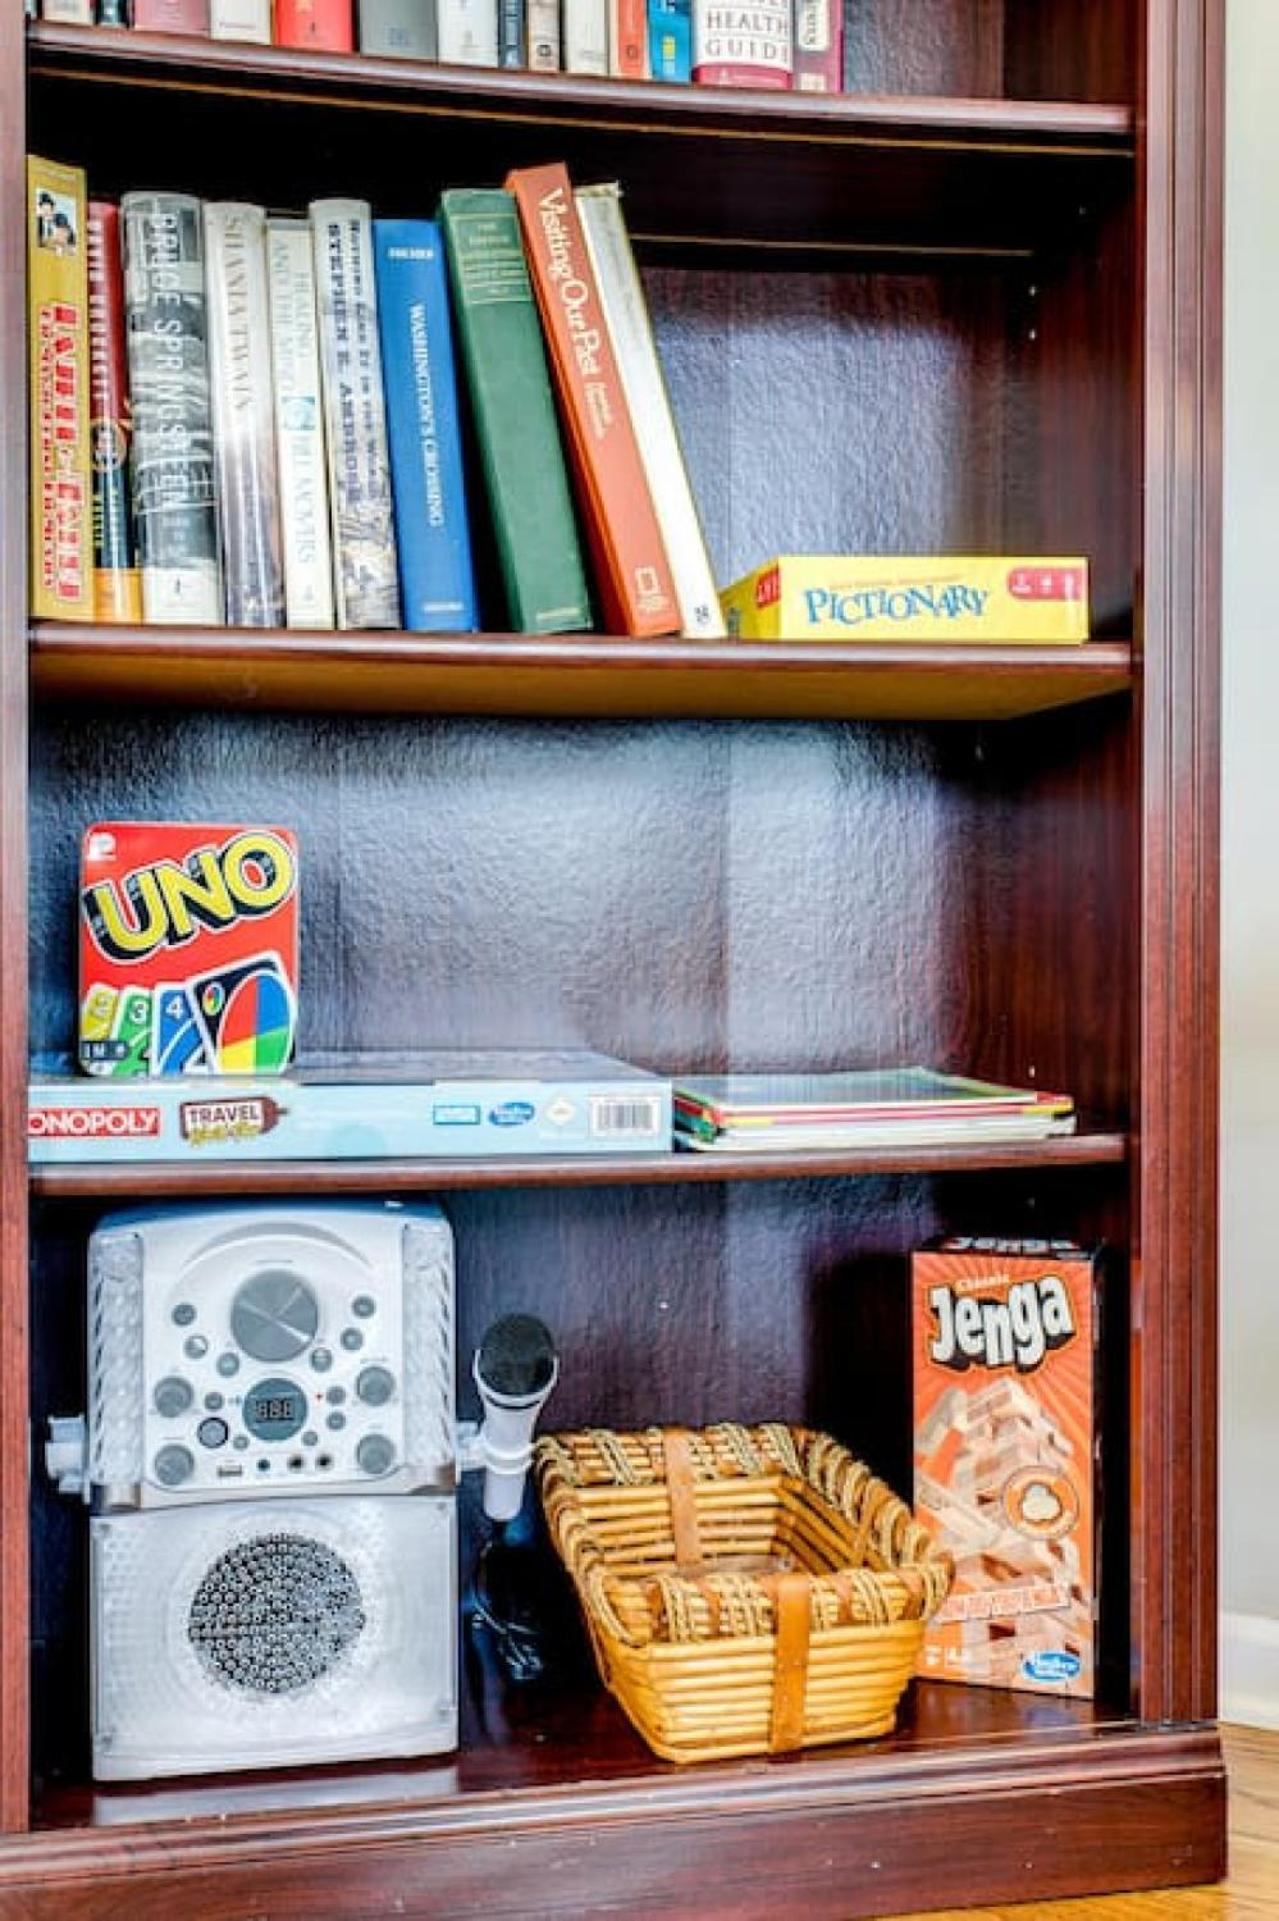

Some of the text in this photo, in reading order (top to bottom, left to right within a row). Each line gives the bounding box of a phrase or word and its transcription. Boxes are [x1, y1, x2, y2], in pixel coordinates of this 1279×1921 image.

[707, 10, 788, 35] HEALTH
[151, 213, 181, 306] BRUCE
[225, 216, 247, 315] SHANIA
[538, 188, 573, 280] Visiting
[560, 280, 588, 331] Our
[571, 329, 602, 376] Past
[154, 319, 189, 507] SPRINGSTEEN
[85, 832, 295, 959] UNO
[28, 1112, 157, 1133] ONOPOLY
[189, 1104, 259, 1122] TRAVEL
[930, 1275, 1076, 1370] Jenga
